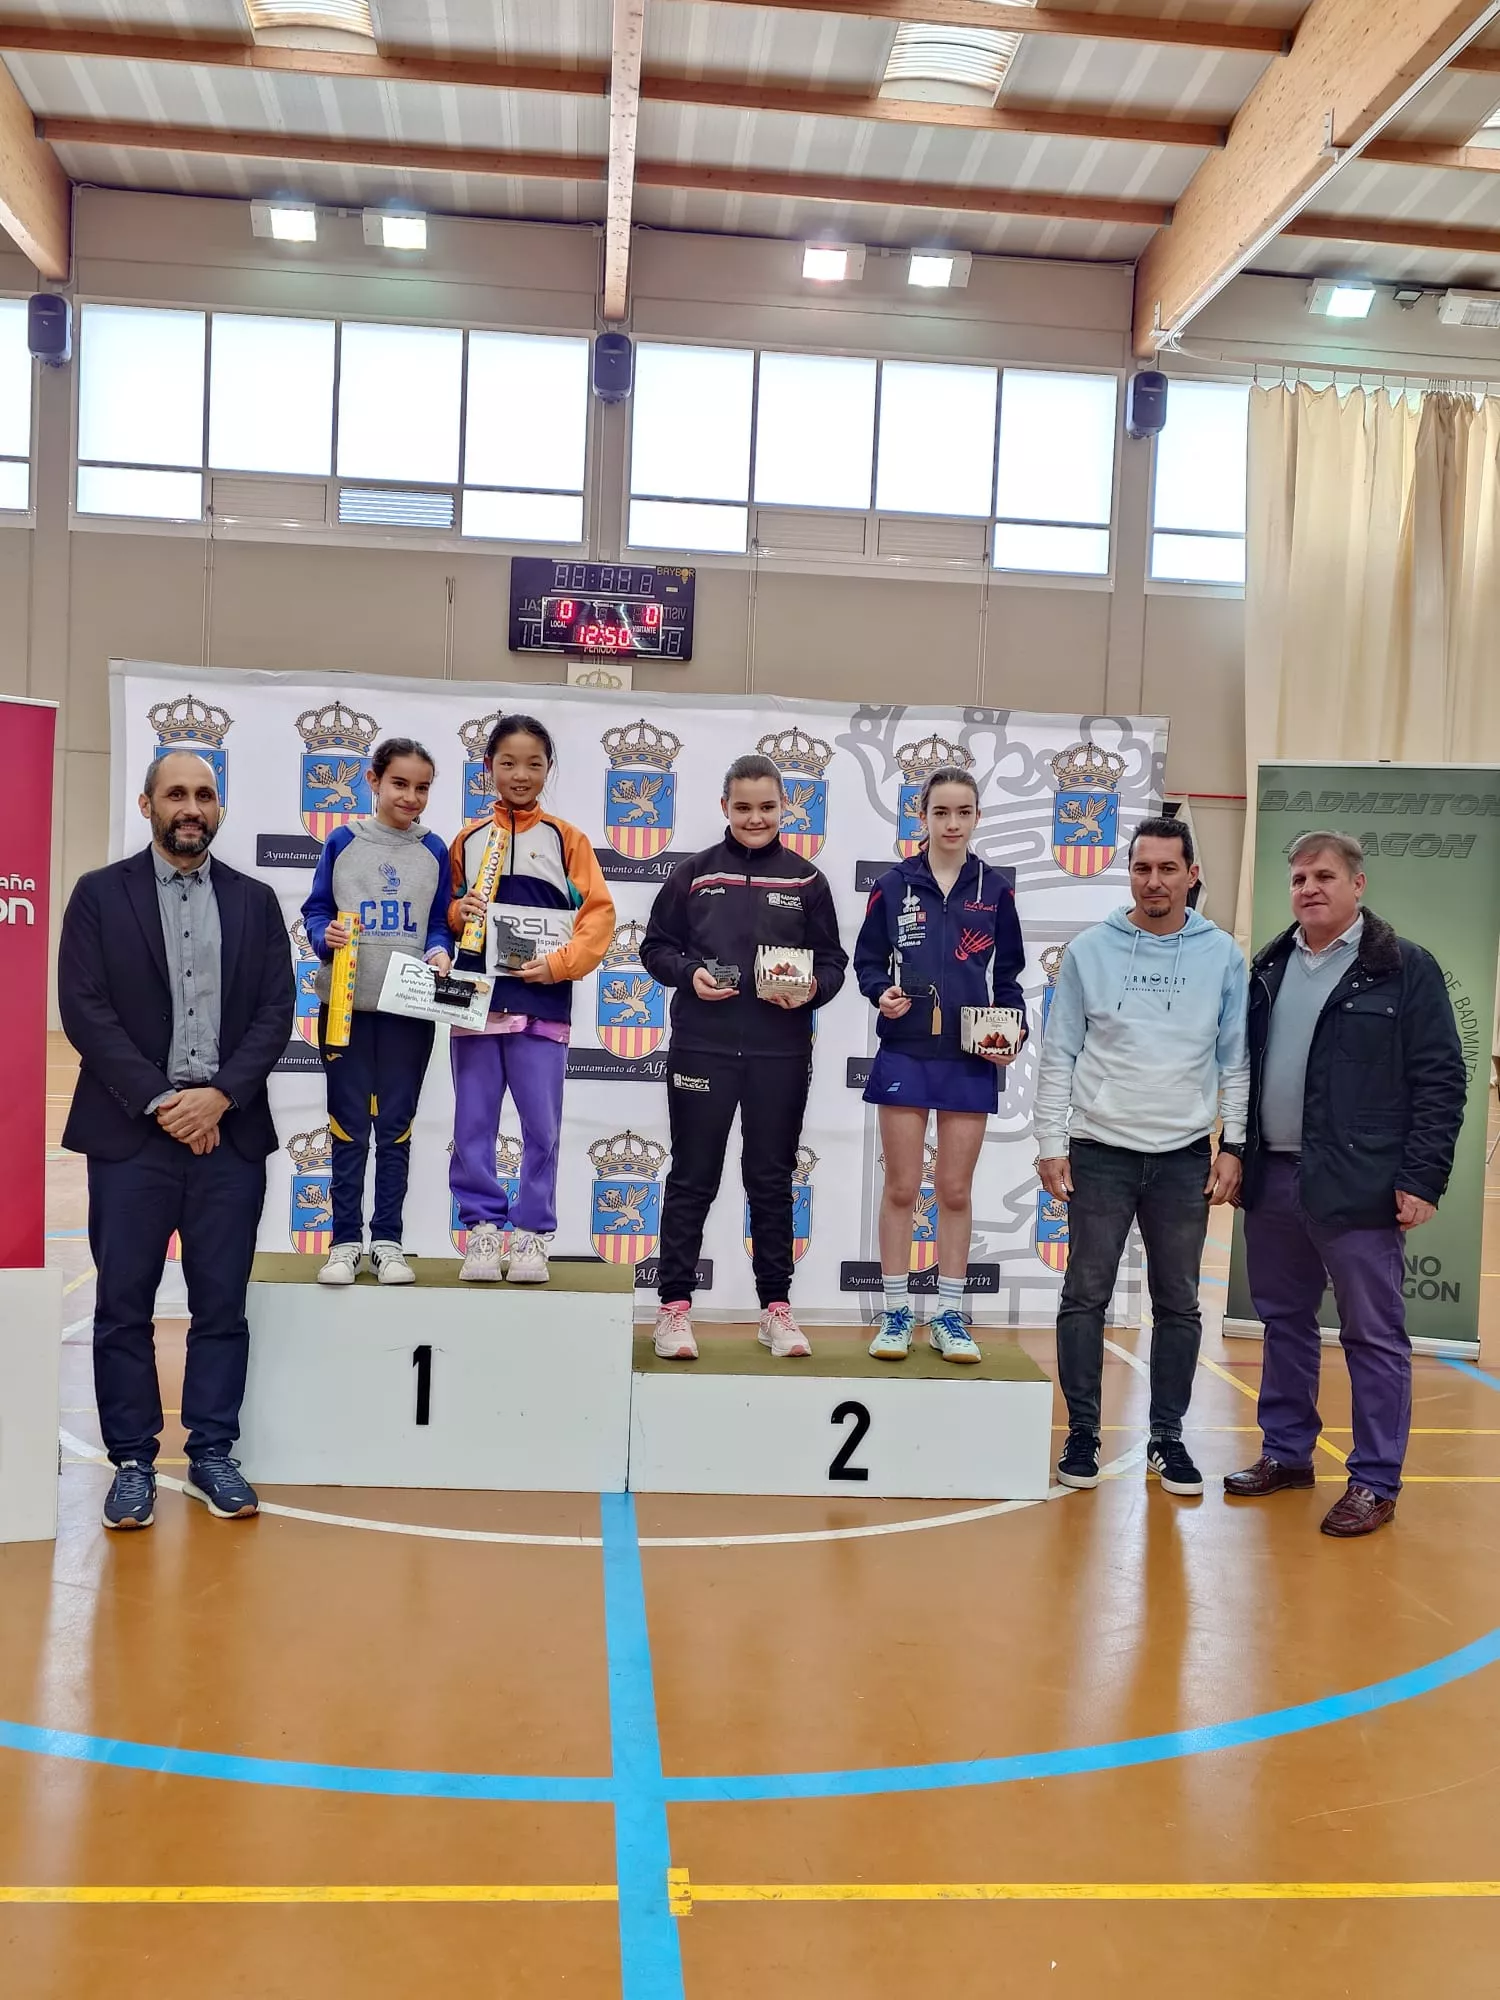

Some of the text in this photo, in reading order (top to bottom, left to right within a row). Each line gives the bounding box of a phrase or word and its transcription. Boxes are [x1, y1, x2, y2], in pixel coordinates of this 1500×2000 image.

[559, 600, 573, 619] 0
[645, 604, 659, 625] 0
[550, 620, 567, 629] LOCAL
[632, 625, 657, 635] VISITANTE
[577, 625, 631, 647] 12:50
[1258, 789, 1500, 817] BADMINTON
[263, 850, 321, 861] Ayuntamien
[634, 865, 645, 874] de
[360, 900, 418, 932] CBL
[500, 914, 560, 937] RSL
[400, 963, 435, 980] RS
[1453, 996, 1480, 1089] BADMINTO
[626, 1064, 637, 1073] de
[412, 1344, 432, 1425] 1
[828, 1400, 871, 1481] 2
